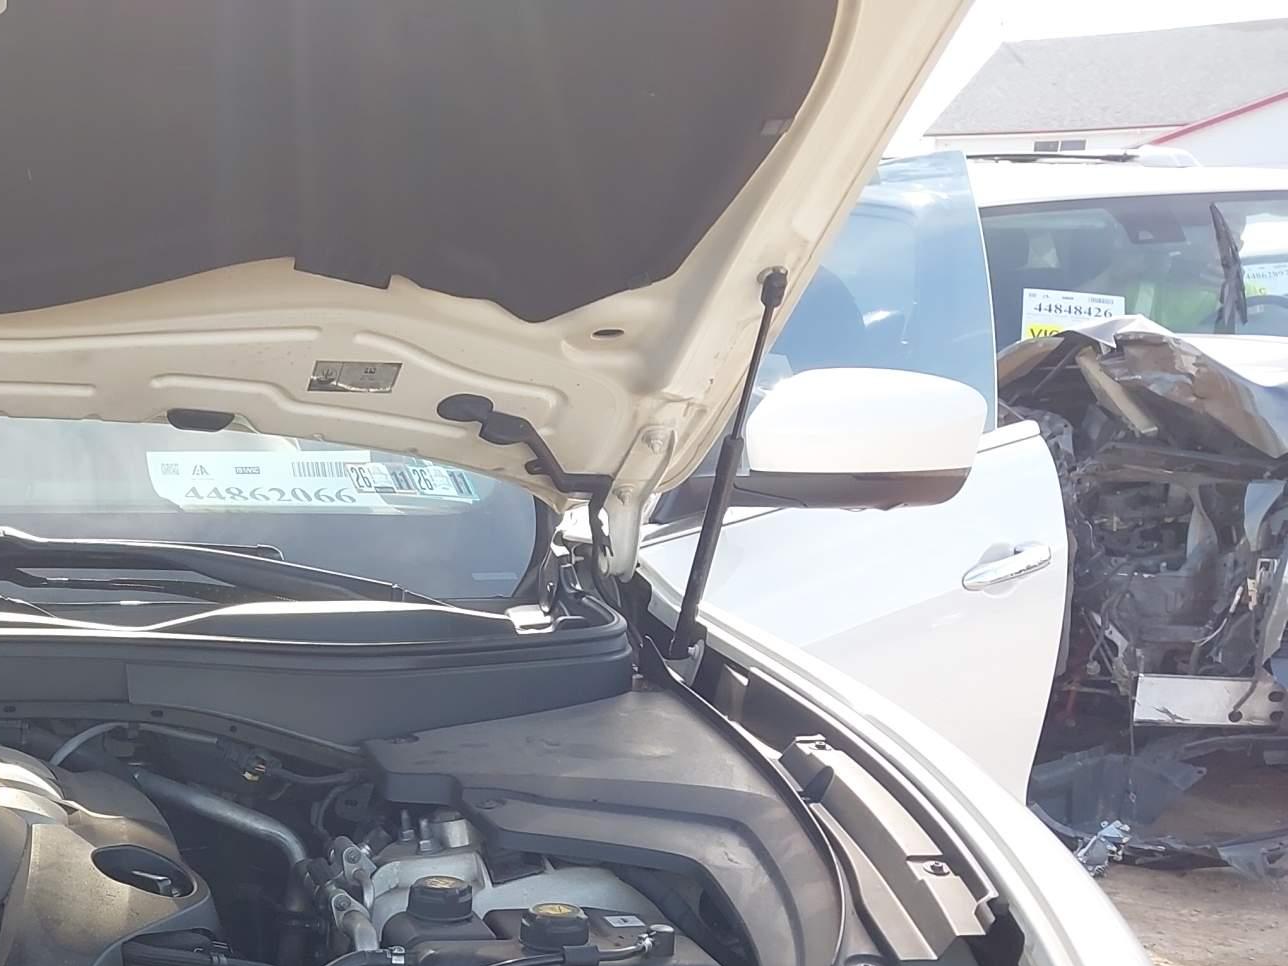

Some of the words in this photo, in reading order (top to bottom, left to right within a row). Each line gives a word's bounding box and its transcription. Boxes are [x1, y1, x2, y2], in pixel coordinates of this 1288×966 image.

[1033, 301, 1113, 318] 44848426
[351, 466, 372, 489] 26
[413, 468, 434, 491] 26
[184, 486, 357, 503] 44862066
